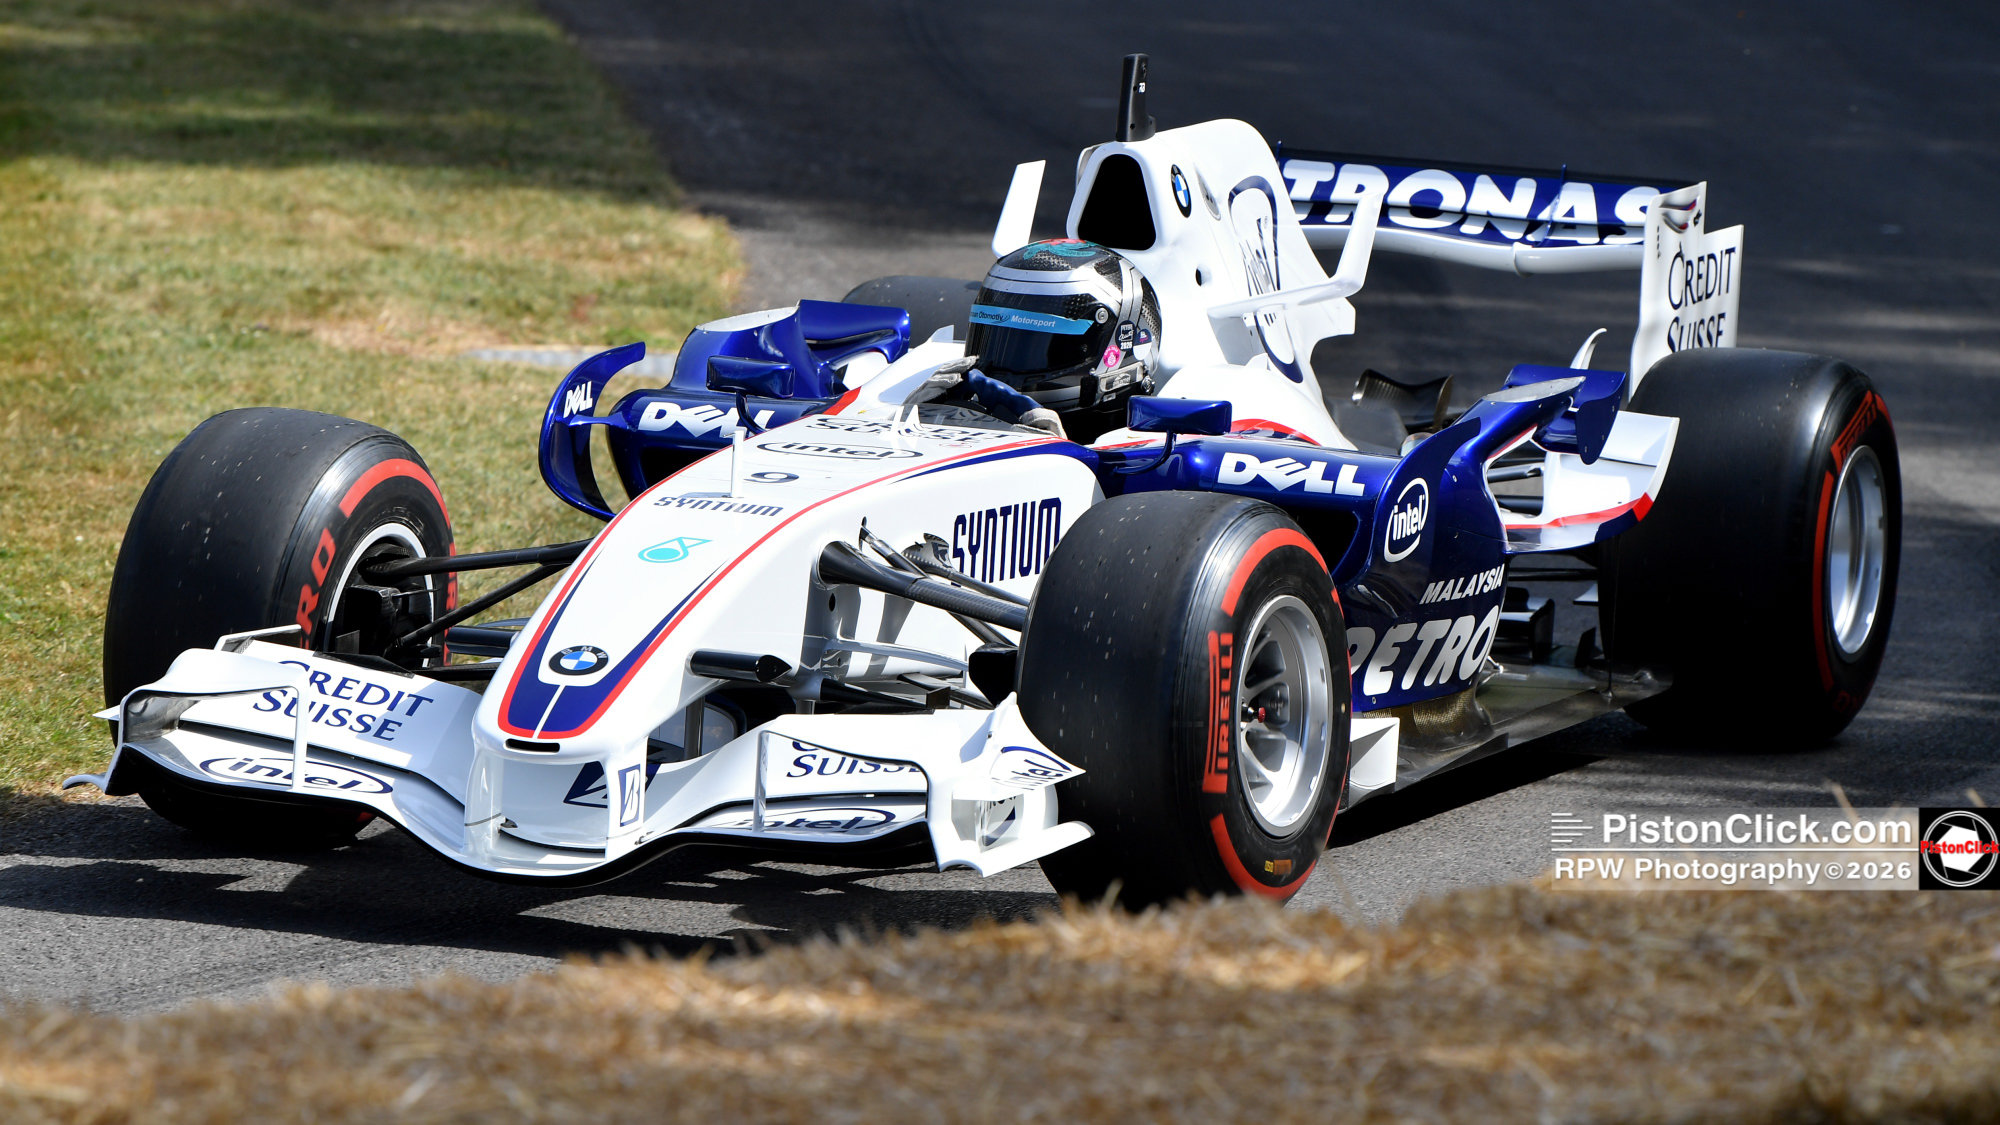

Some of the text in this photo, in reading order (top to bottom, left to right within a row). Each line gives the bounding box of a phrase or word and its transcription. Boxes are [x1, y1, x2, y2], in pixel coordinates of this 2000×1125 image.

[1668, 241, 1736, 311] CREDIT
[1010, 314, 1056, 328] Motorsport
[563, 381, 593, 418] DELL
[783, 441, 894, 458] intel
[744, 471, 800, 483] 9
[1217, 452, 1366, 496] DELL
[653, 496, 784, 517] SYNTIUM
[1393, 495, 1423, 541] intel
[953, 497, 1062, 587] SYNTIUM
[1419, 564, 1505, 605] MALAYSIA
[1202, 630, 1234, 793] PIRELLI
